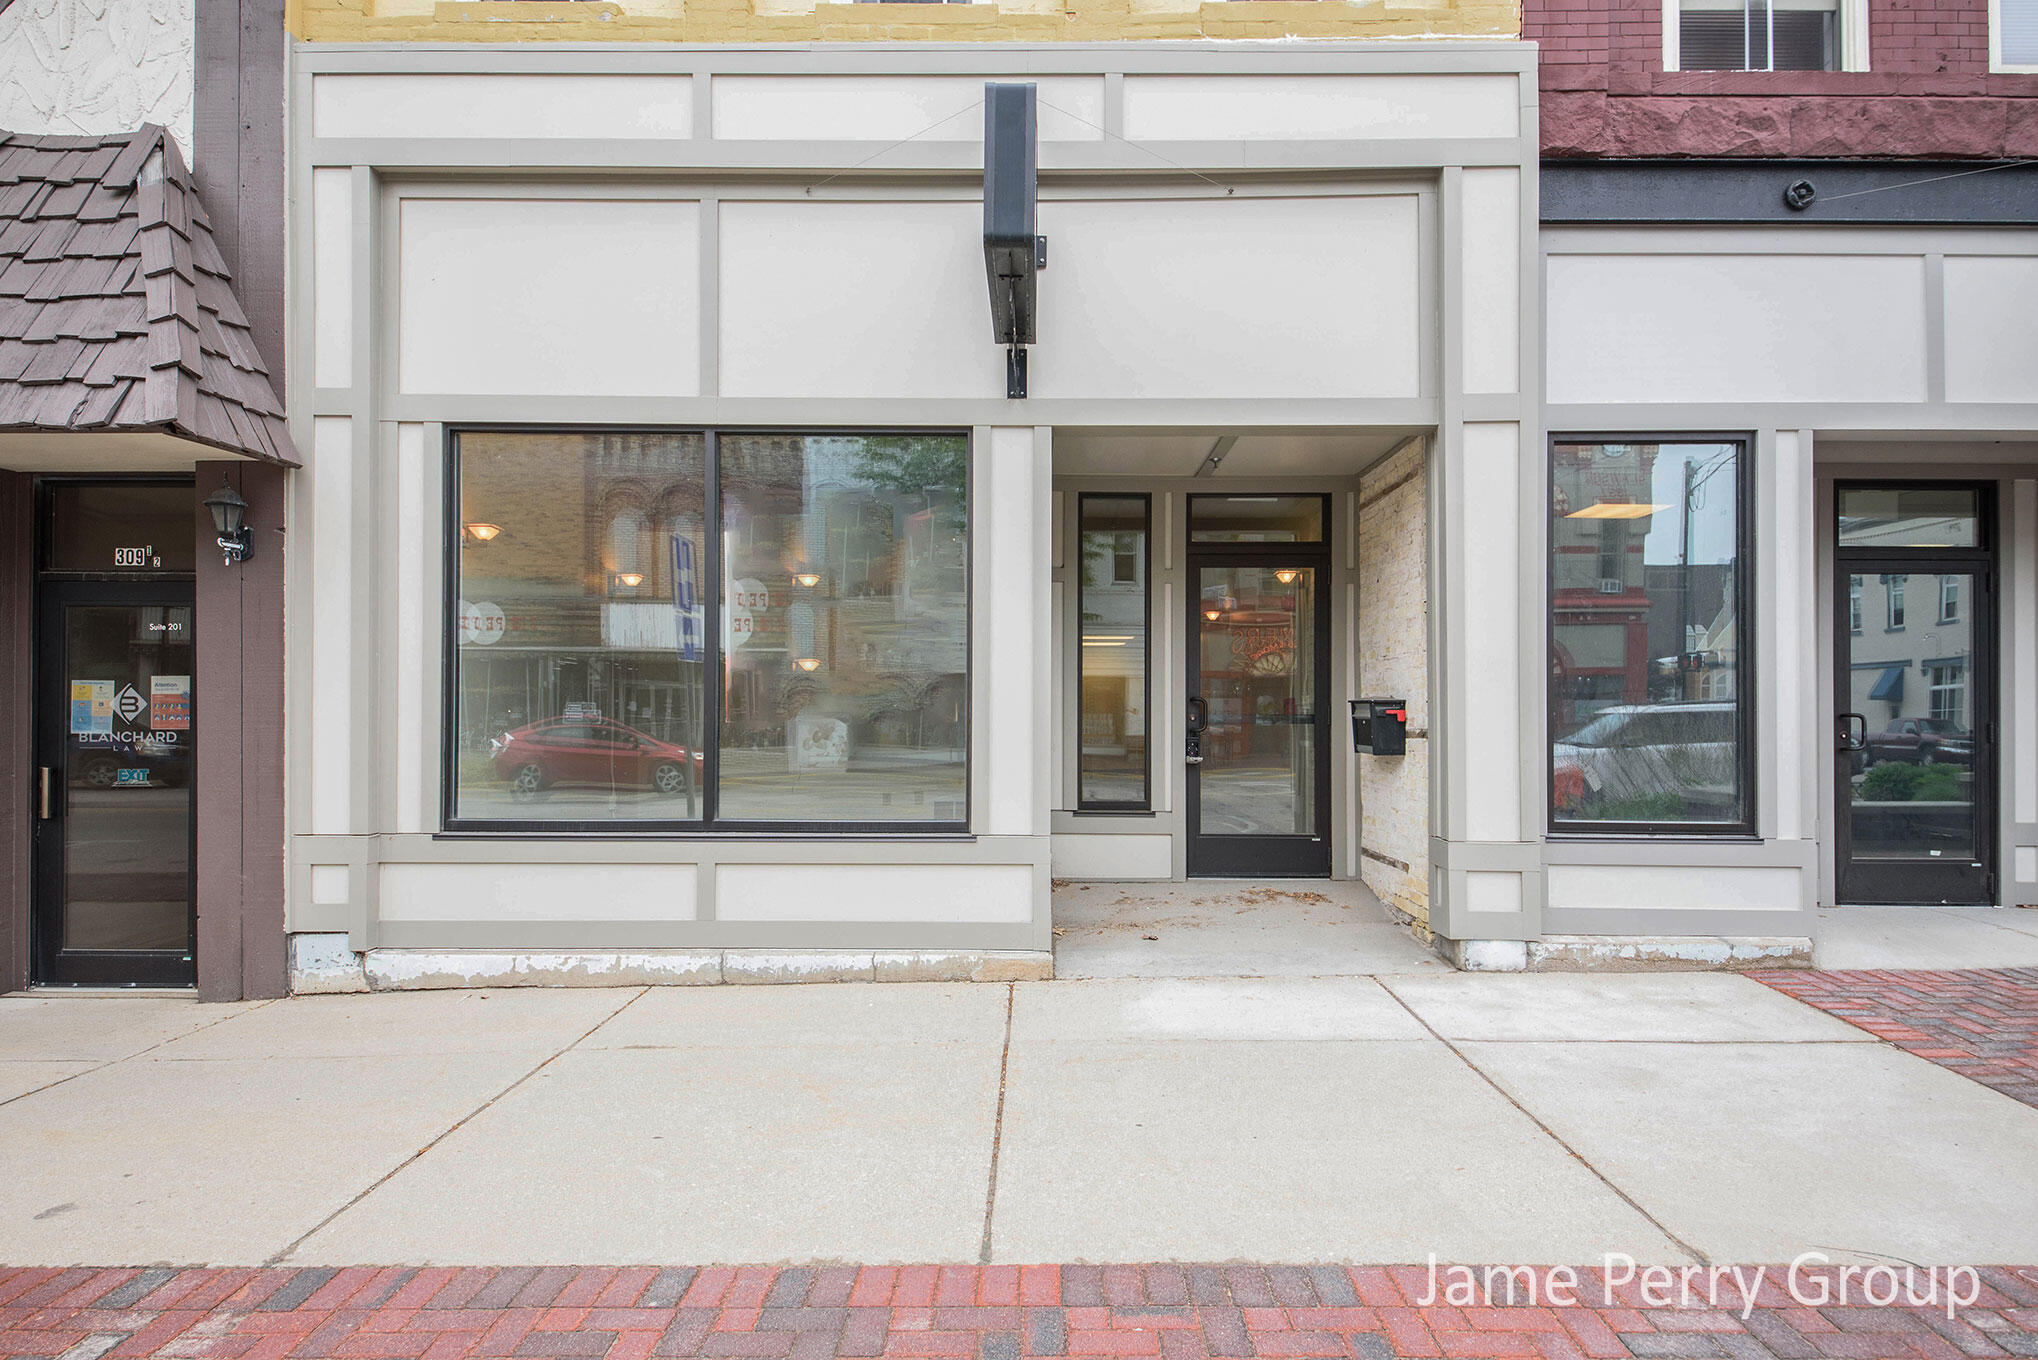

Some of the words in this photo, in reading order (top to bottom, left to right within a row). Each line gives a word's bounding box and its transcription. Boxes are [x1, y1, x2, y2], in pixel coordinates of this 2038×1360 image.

[116, 548, 144, 565] 309
[149, 623, 166, 631] Suite
[168, 623, 182, 631] 201
[79, 731, 177, 743] BLANCHARD
[118, 768, 149, 784] EXIT
